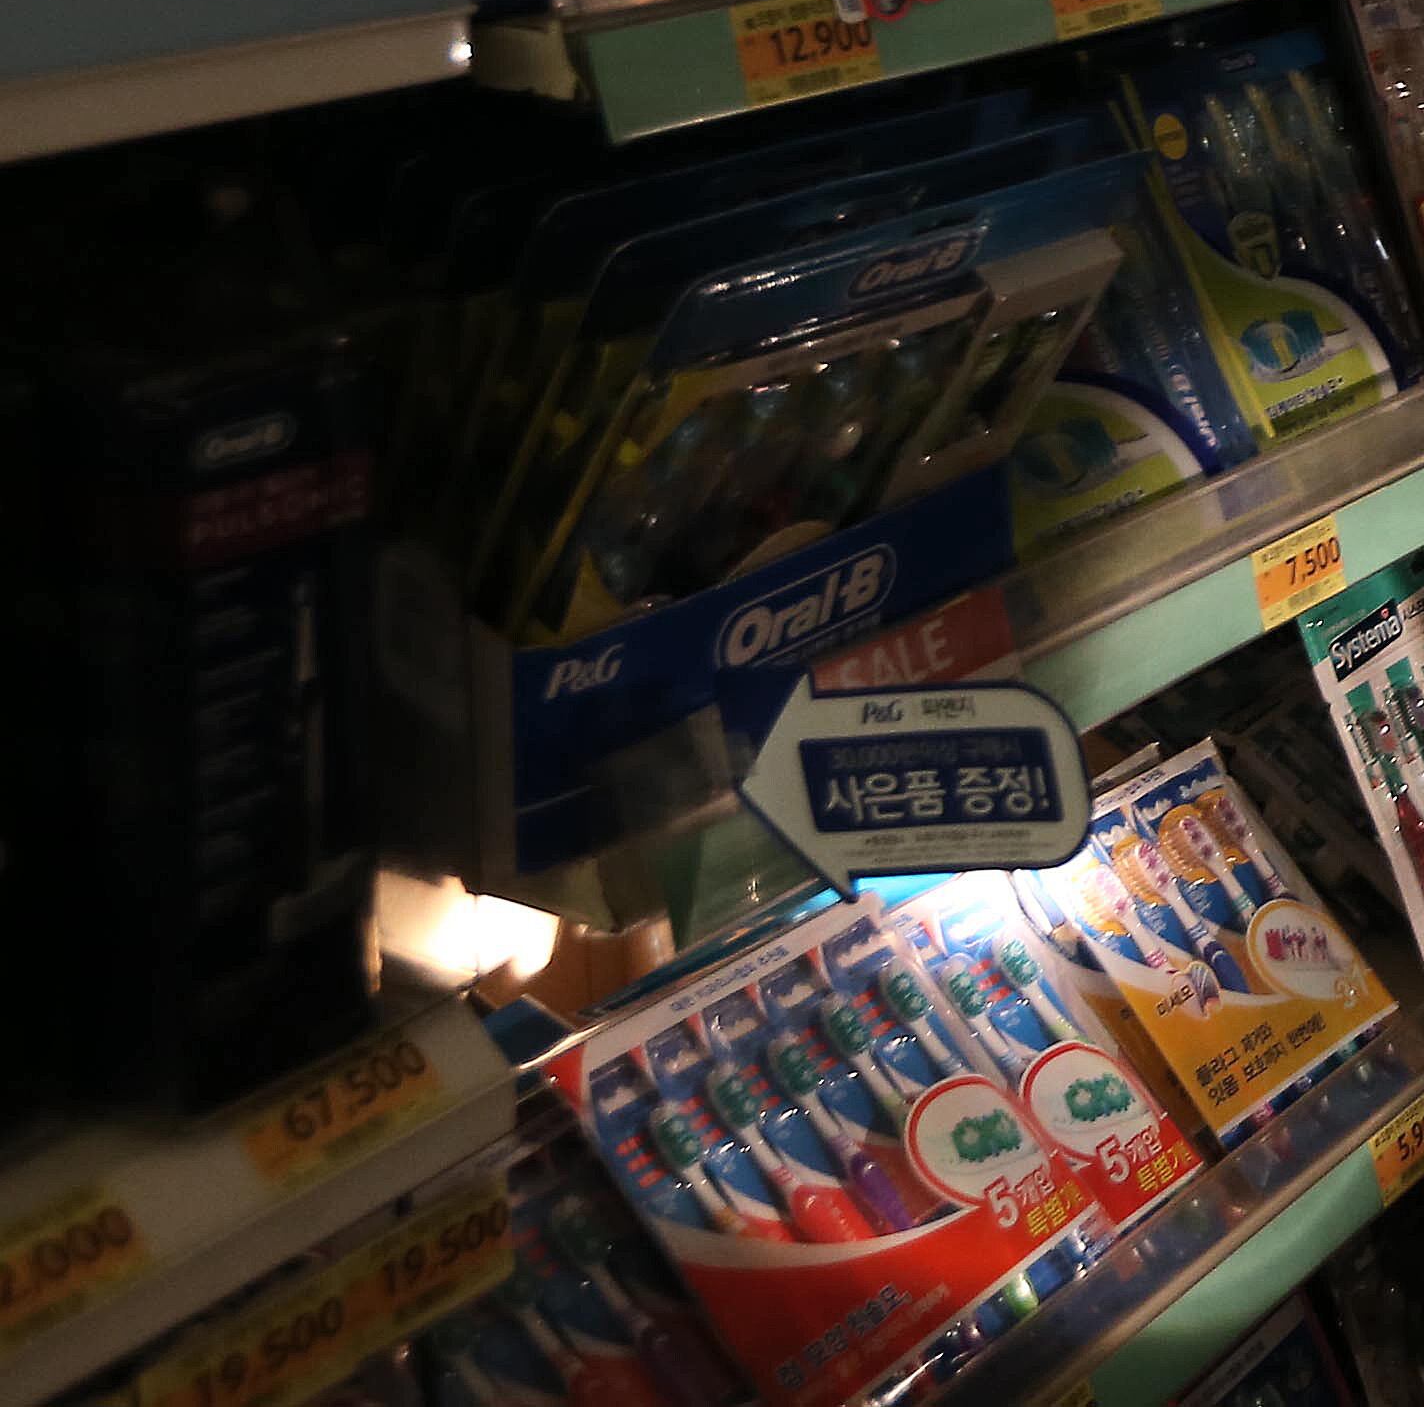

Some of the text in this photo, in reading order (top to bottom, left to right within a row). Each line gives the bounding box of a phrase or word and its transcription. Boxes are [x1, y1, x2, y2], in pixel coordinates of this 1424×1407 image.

[1285, 536, 1342, 585] 7,500
[723, 552, 888, 667] Oral-B
[544, 642, 624, 700] P&G
[1331, 612, 1403, 671] Systema
[825, 765, 1050, 824] 사은품 증정!
[283, 1041, 427, 1140] 67,500
